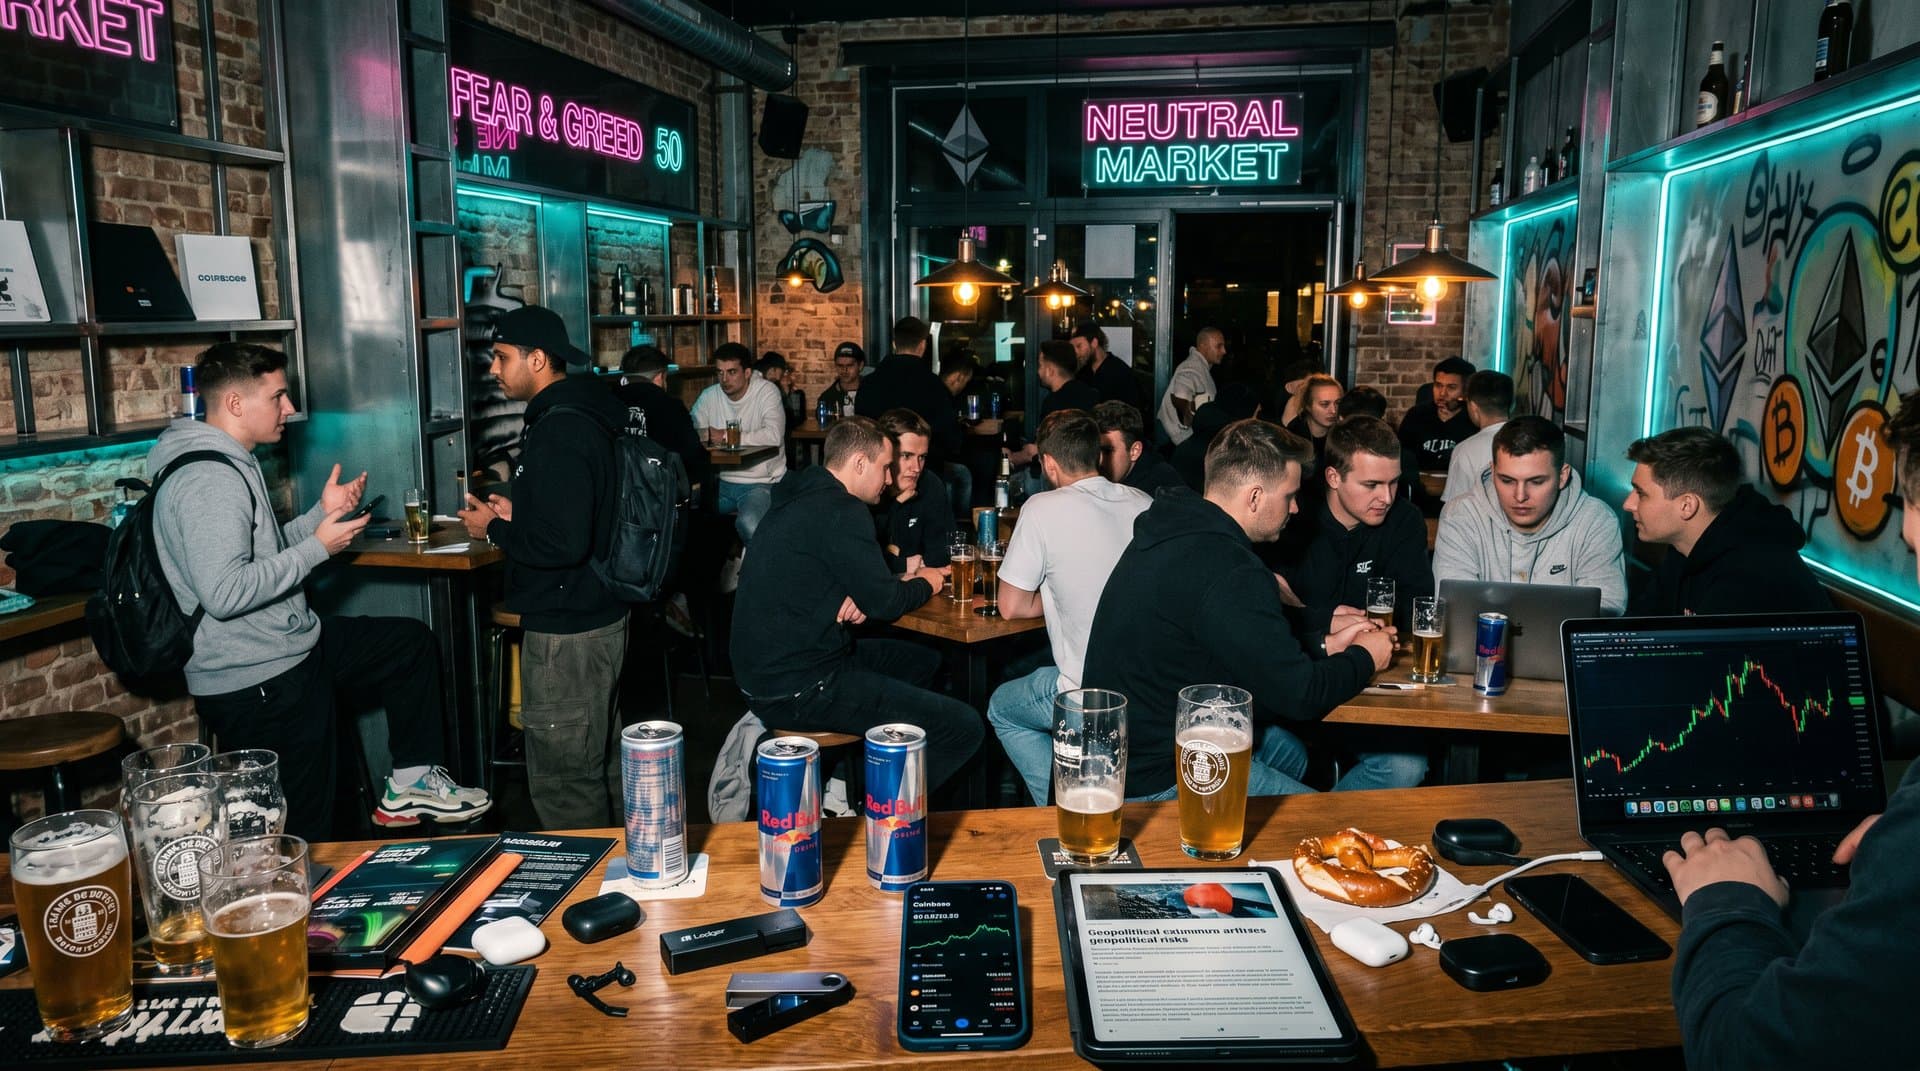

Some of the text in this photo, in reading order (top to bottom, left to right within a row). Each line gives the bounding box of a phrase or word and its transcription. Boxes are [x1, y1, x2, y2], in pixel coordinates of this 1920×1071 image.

[451, 67, 683, 173] FEAR & GREED 50
[1087, 99, 1298, 141] NEUTRAL
[1096, 143, 1289, 183] MARKET
[761, 808, 792, 829] Red
[866, 793, 892, 815] Red
[1090, 936, 1157, 945] geopolitical
